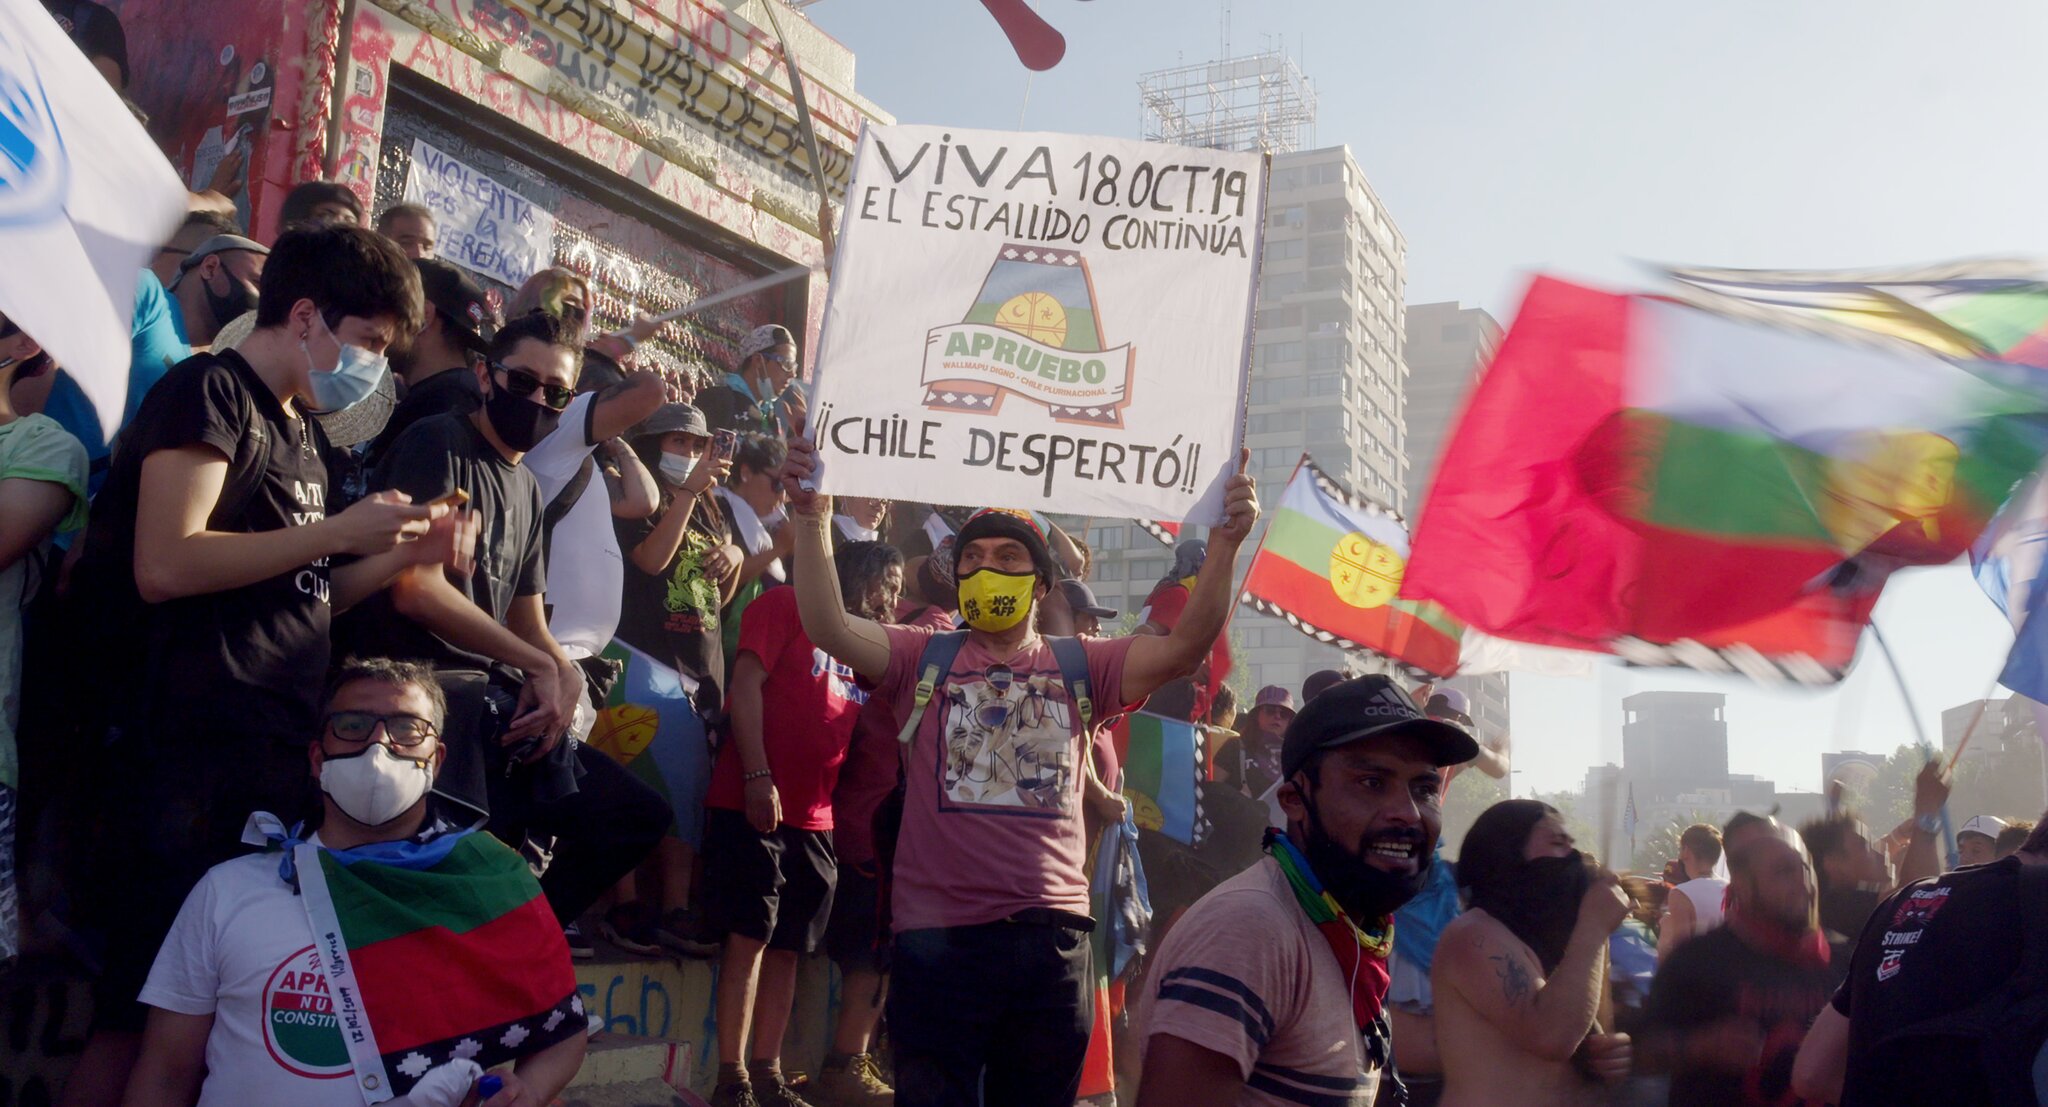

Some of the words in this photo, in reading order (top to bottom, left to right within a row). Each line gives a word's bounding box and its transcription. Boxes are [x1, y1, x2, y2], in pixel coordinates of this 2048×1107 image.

[422, 145, 535, 226] VIOLENTA
[860, 186, 901, 223] EL
[944, 331, 1107, 384] APRUEBO
[942, 361, 989, 372] WALLMAPU
[990, 366, 1016, 379] DIGNO
[1020, 377, 1043, 391] CHILE
[1043, 385, 1107, 397] PLURINACIONAL
[990, 606, 1015, 617] AFP
[1364, 703, 1421, 720] adida
[1881, 929, 1924, 946] STRIKE!
[274, 1011, 338, 1029] CONSTIT
